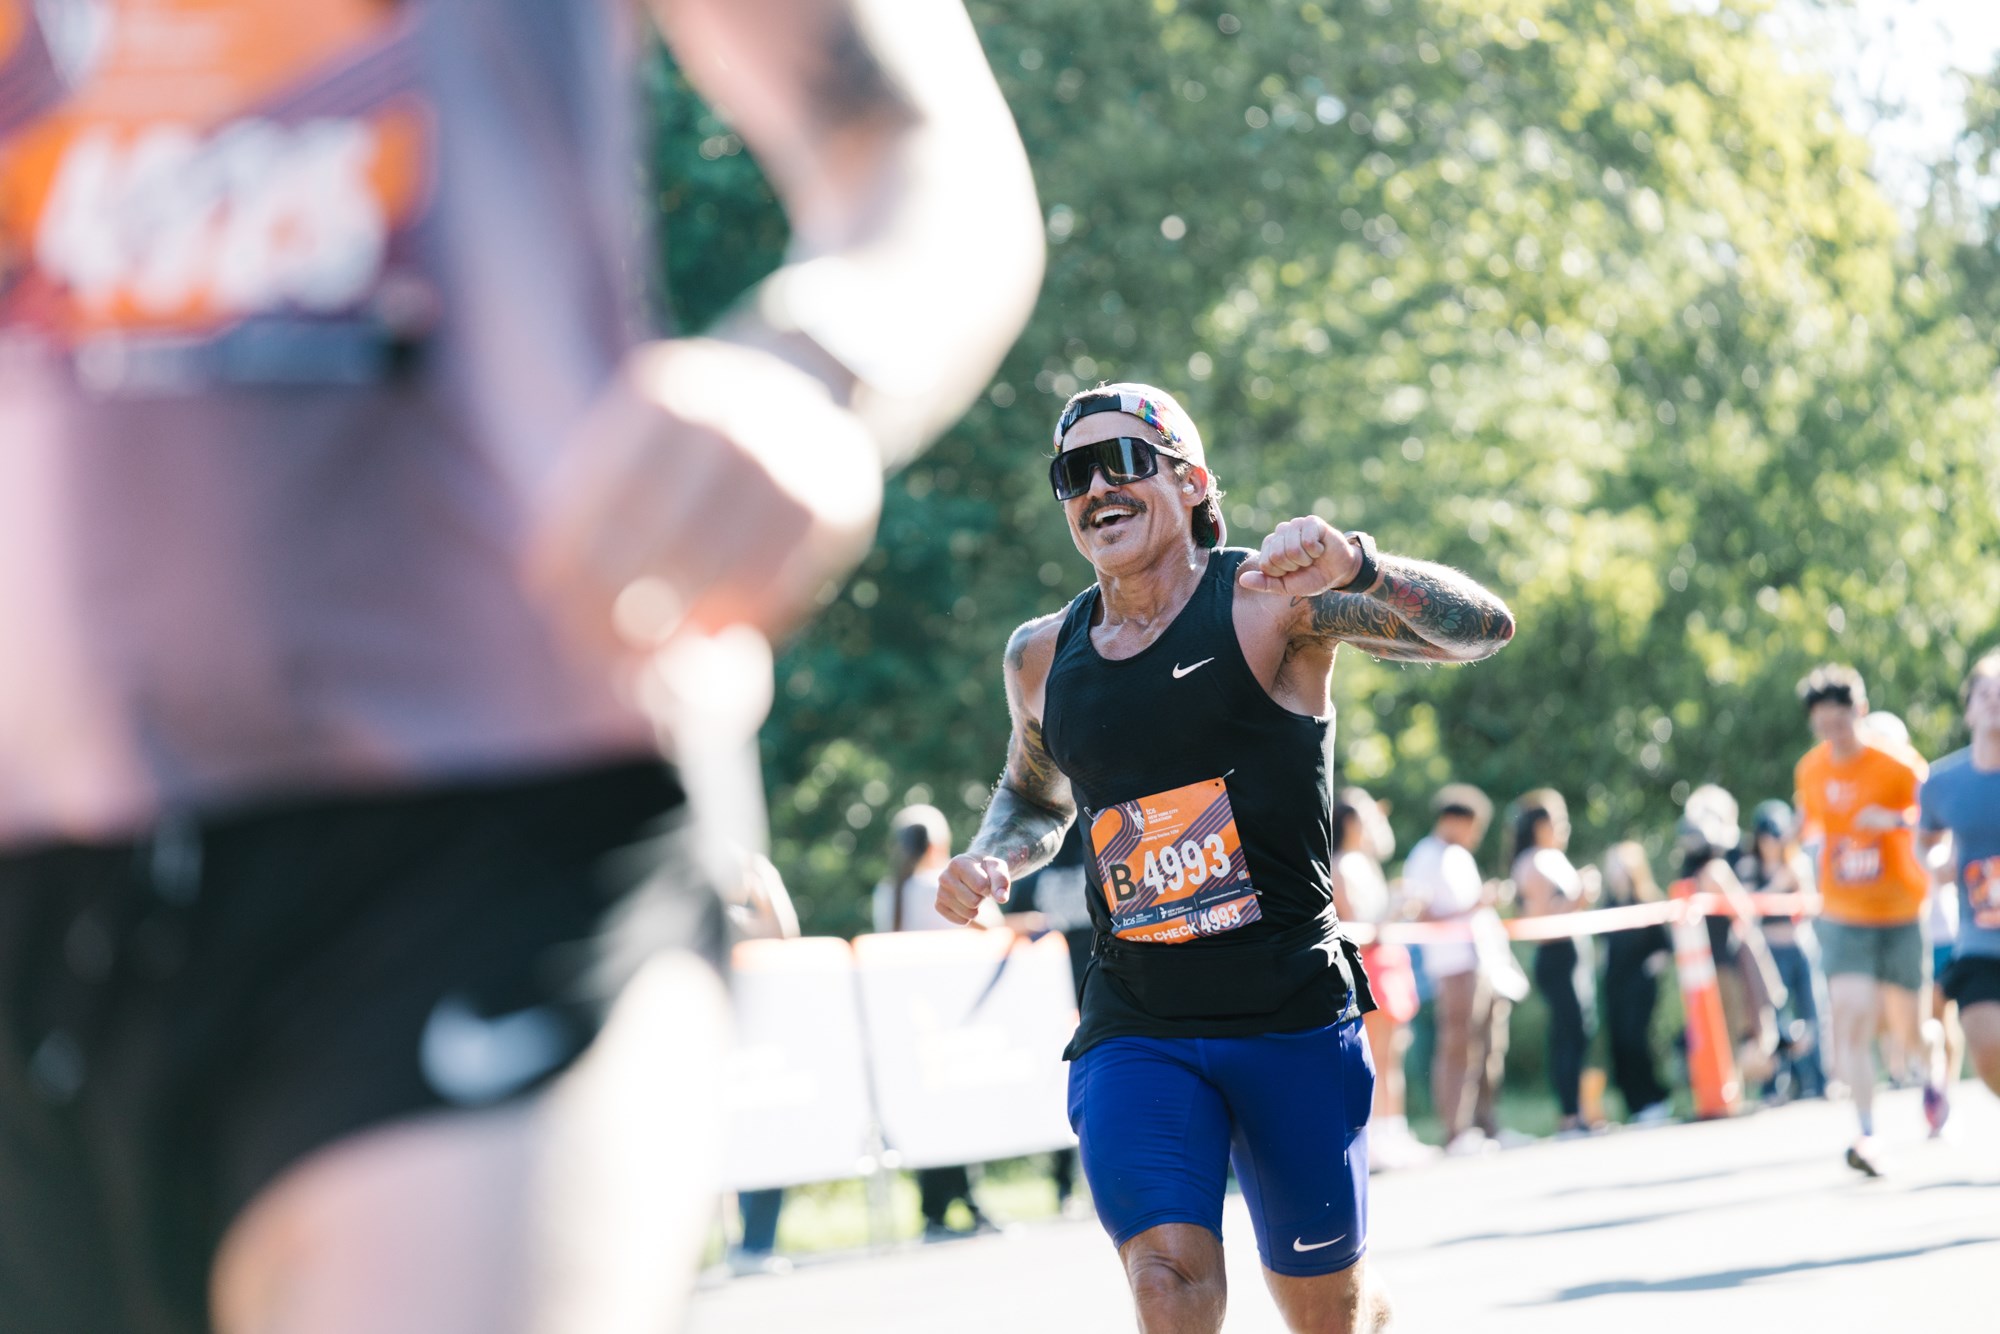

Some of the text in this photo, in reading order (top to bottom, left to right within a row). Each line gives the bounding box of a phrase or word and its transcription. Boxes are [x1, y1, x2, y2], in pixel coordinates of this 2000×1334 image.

[1109, 834, 1231, 901] B 4993
[1153, 923, 1199, 941] CHECK
[1200, 904, 1241, 933] 4993
